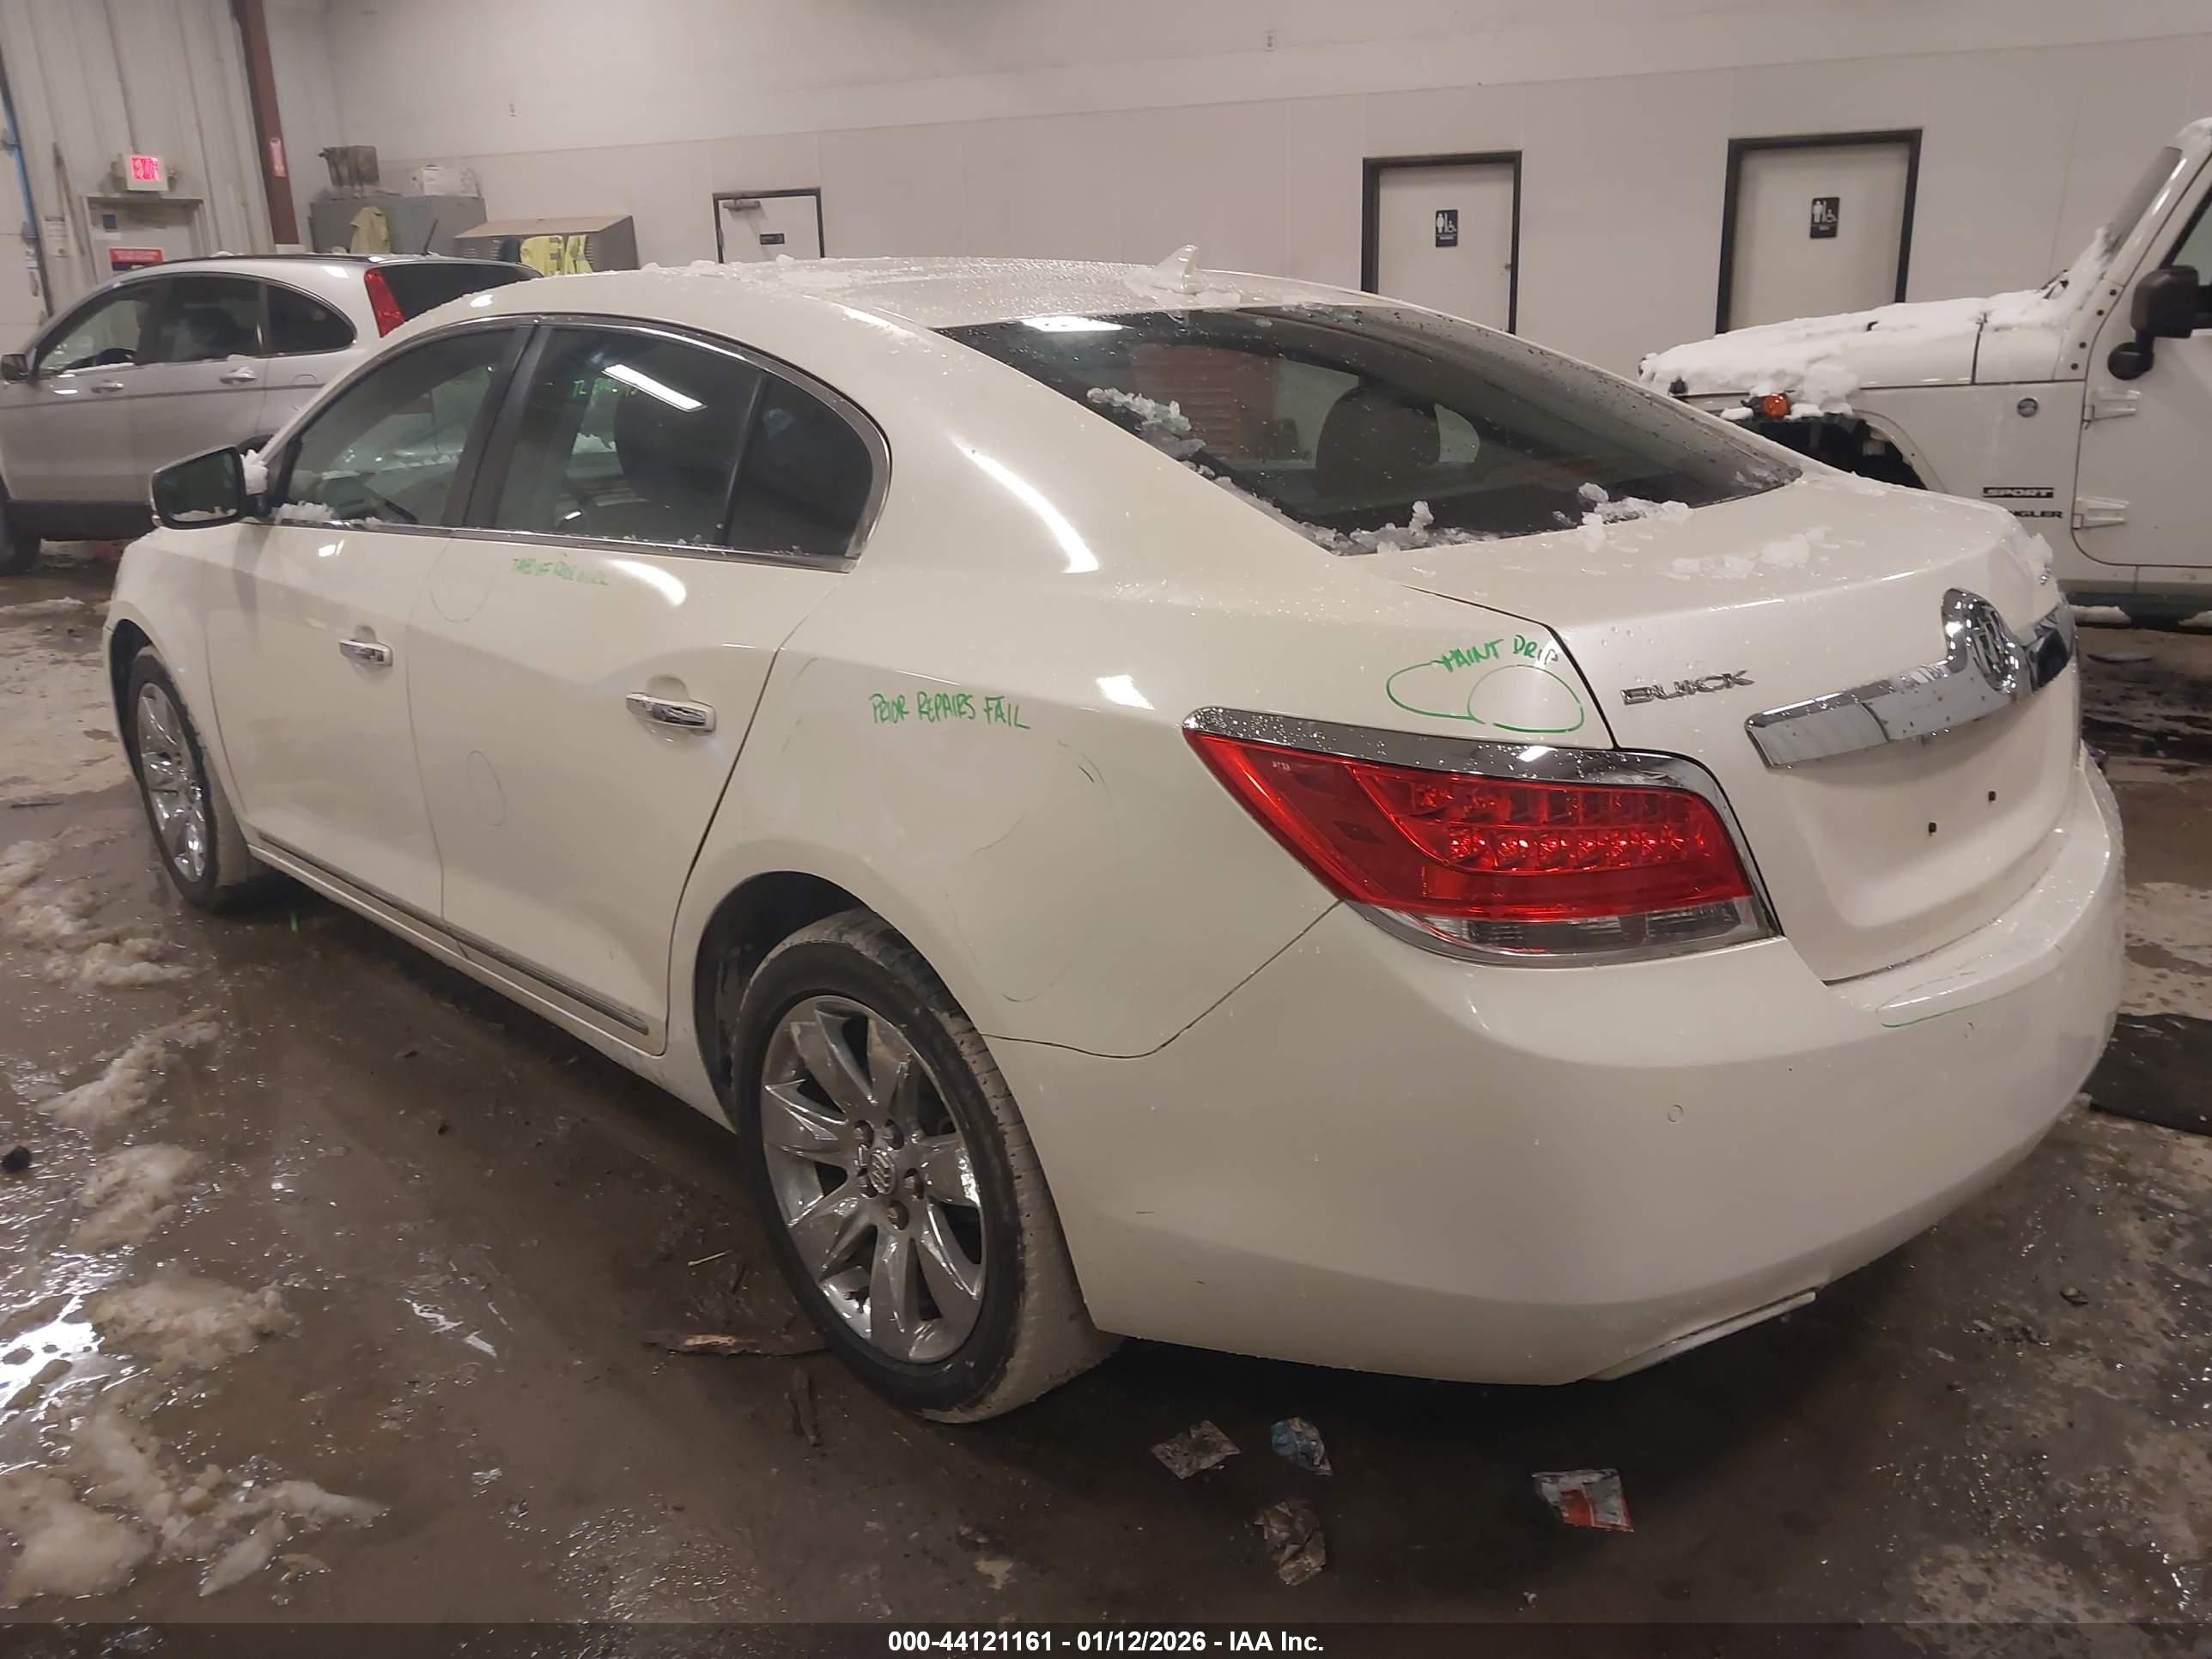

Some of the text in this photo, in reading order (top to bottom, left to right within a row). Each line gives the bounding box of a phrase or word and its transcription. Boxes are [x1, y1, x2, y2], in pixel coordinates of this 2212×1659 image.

[1984, 487, 2053, 497] SPORT
[2008, 510, 2063, 519] NGLER
[1442, 635, 1559, 672] PAINT DRIP
[1620, 670, 1755, 706] BUICK
[917, 691, 975, 723] REPAIRS
[983, 696, 1030, 730] FAIL
